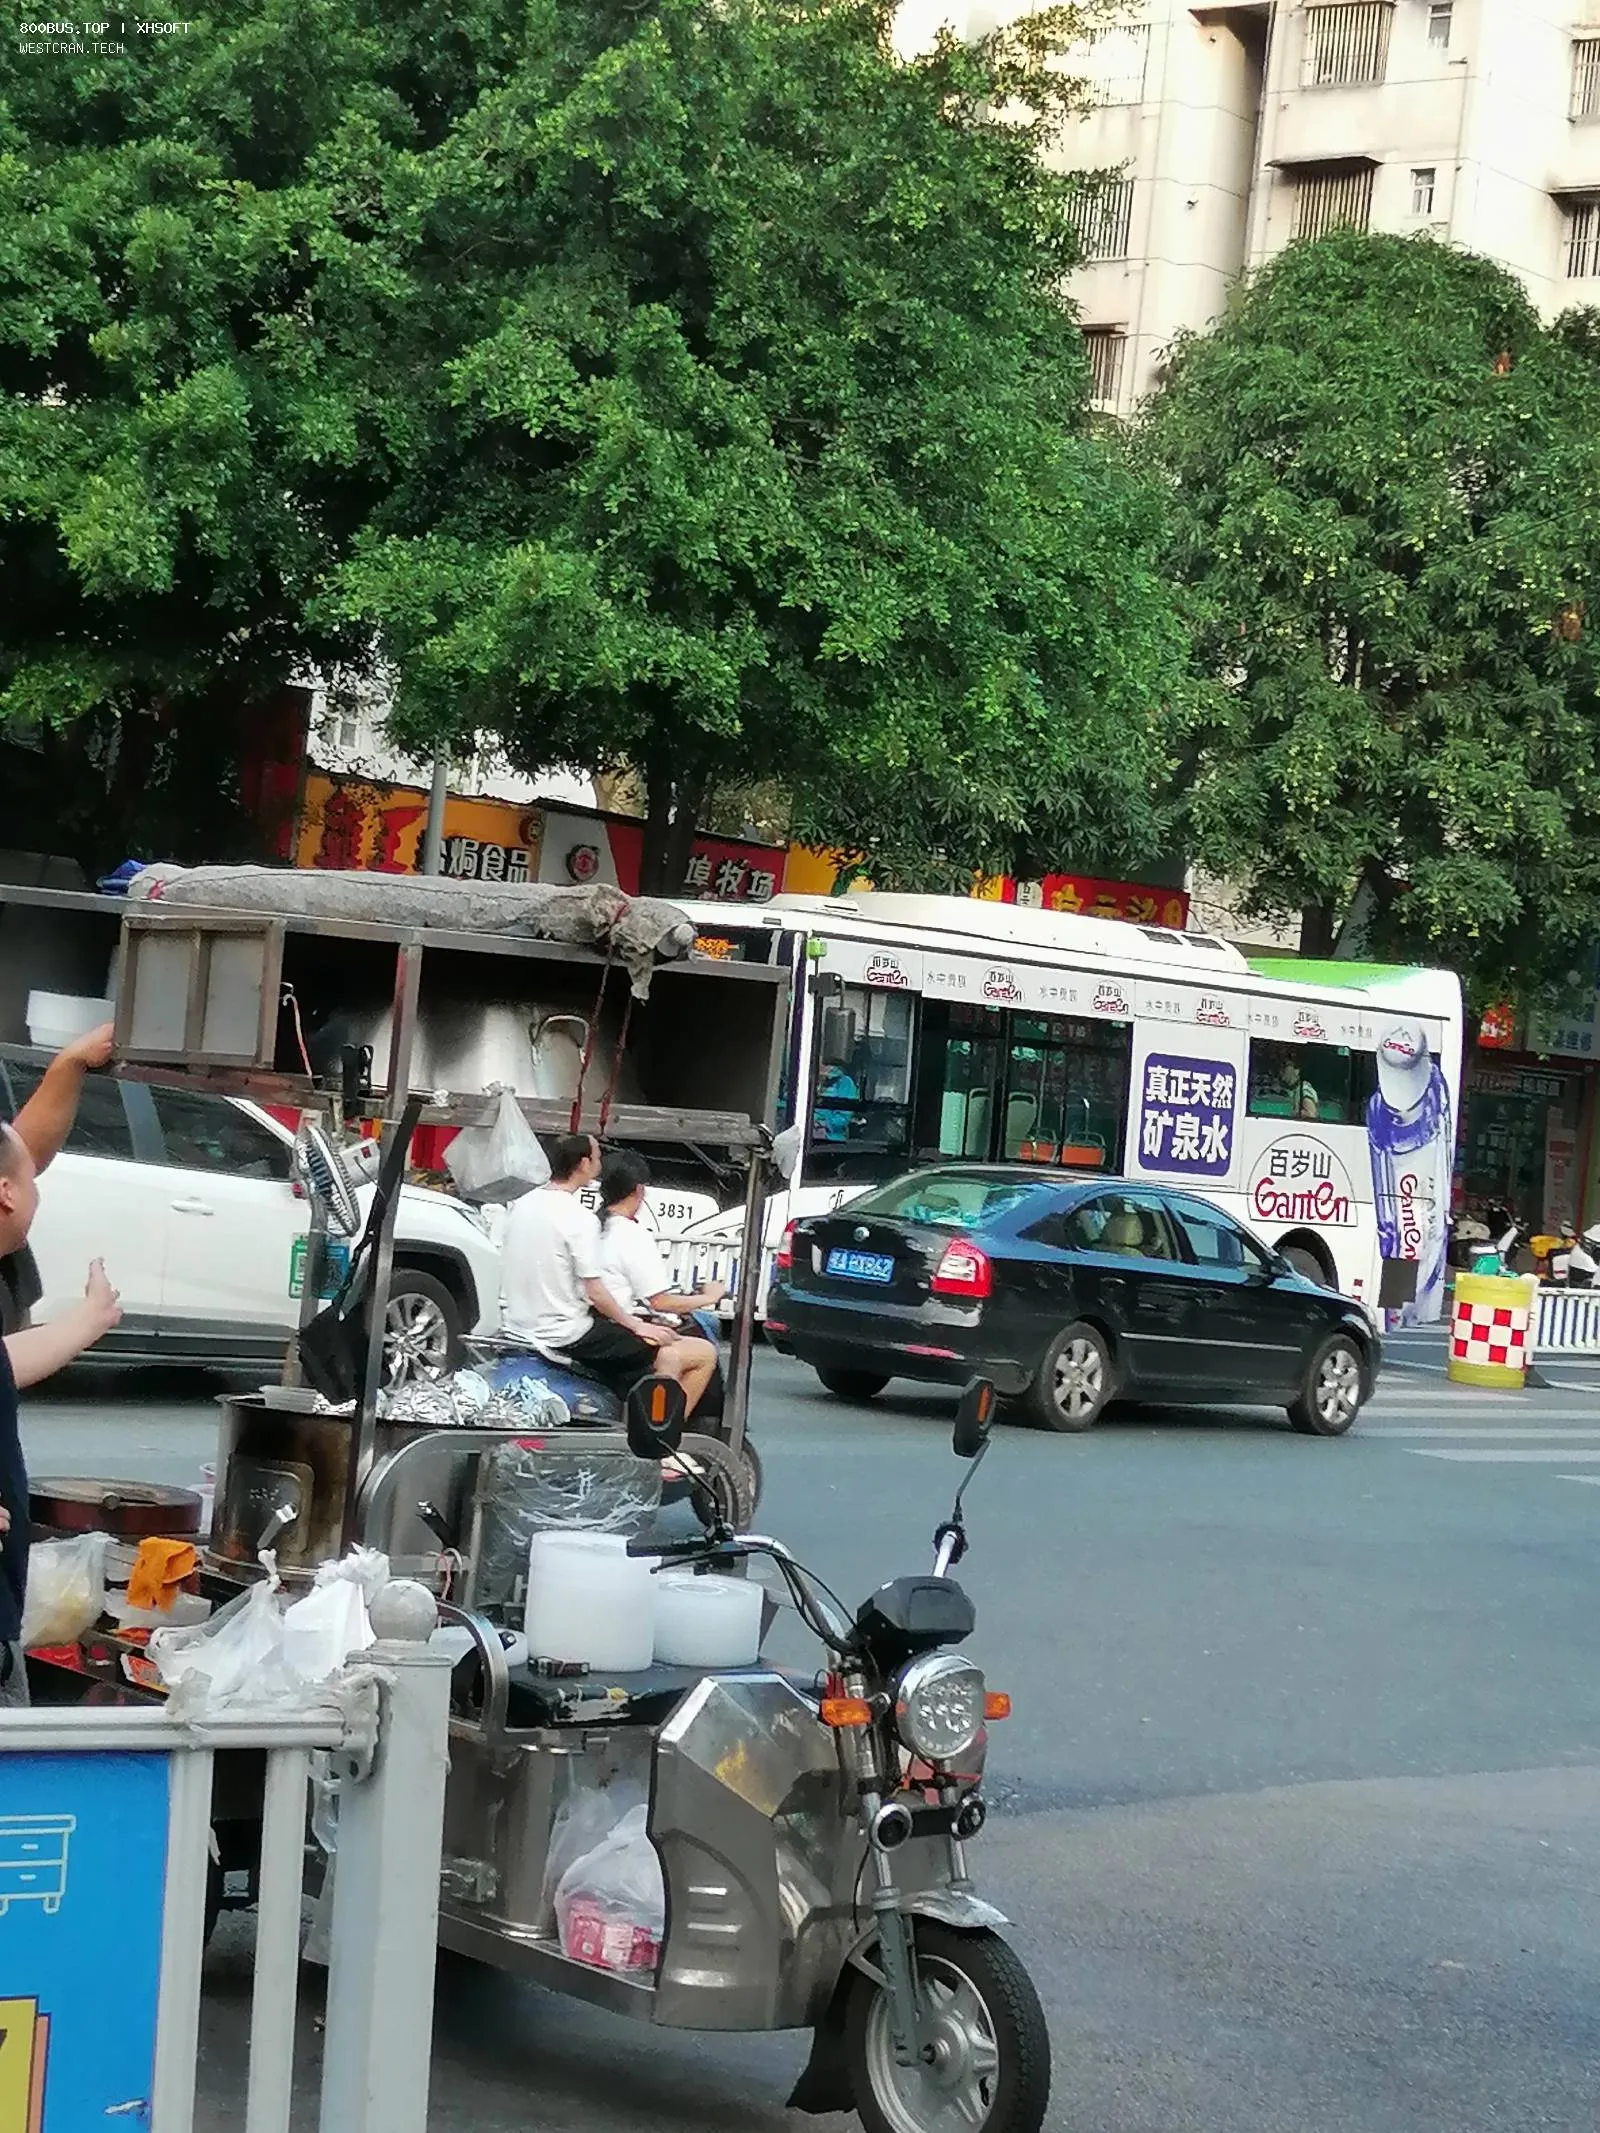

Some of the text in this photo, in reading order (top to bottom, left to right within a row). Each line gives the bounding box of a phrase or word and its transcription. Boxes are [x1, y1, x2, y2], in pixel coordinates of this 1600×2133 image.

[1145, 1065, 1234, 1110] 真正天然
[1143, 1108, 1229, 1163] 矿泉水
[1269, 1147, 1332, 1179] 百岁山
[657, 1202, 693, 1220] 3831
[1254, 1176, 1349, 1224] Ganten
